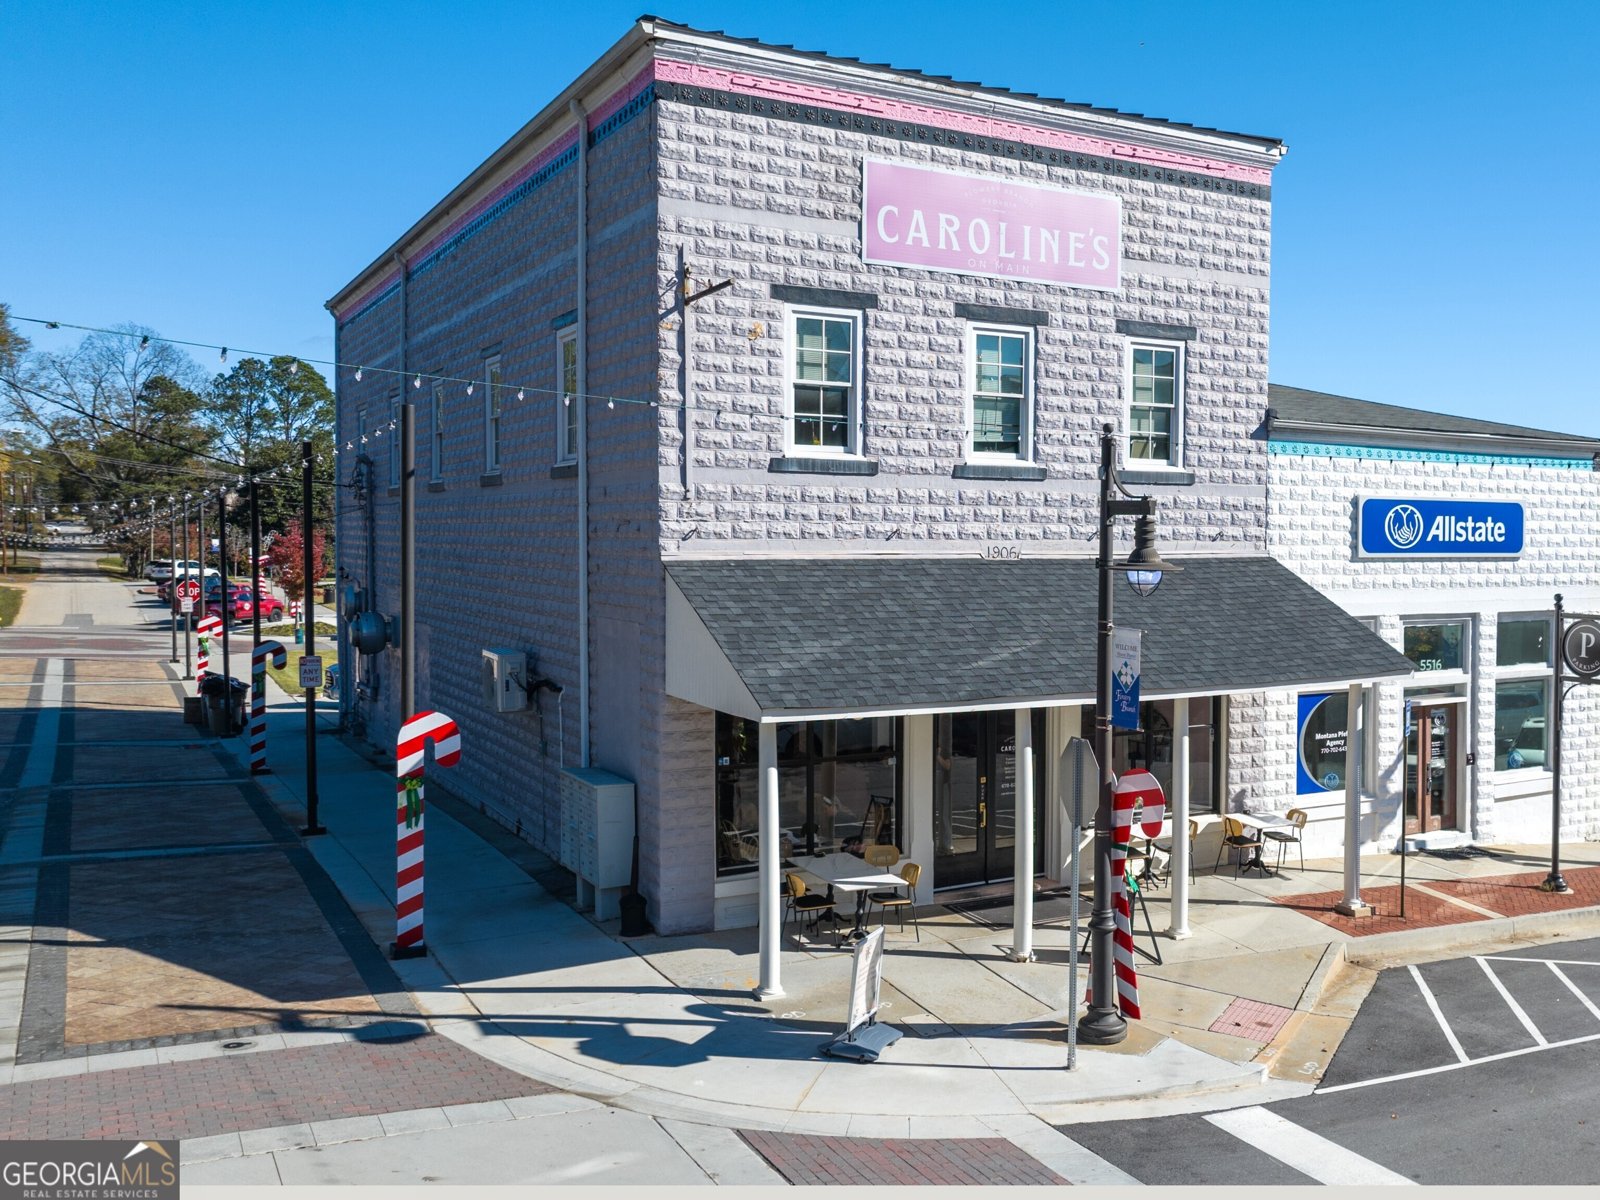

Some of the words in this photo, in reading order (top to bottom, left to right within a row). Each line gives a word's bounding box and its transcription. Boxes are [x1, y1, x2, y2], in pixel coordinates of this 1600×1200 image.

[876, 205, 1110, 271] CAROLINE'S
[967, 258, 987, 269] ON
[995, 262, 1030, 275] MAIN
[1426, 515, 1506, 542] Allstate
[987, 545, 1017, 559] 1906
[178, 587, 200, 597] SOP
[1579, 632, 1596, 658] P
[1420, 658, 1442, 671] 5516
[1315, 732, 1337, 740] Montana
[1326, 739, 1345, 747] Agency
